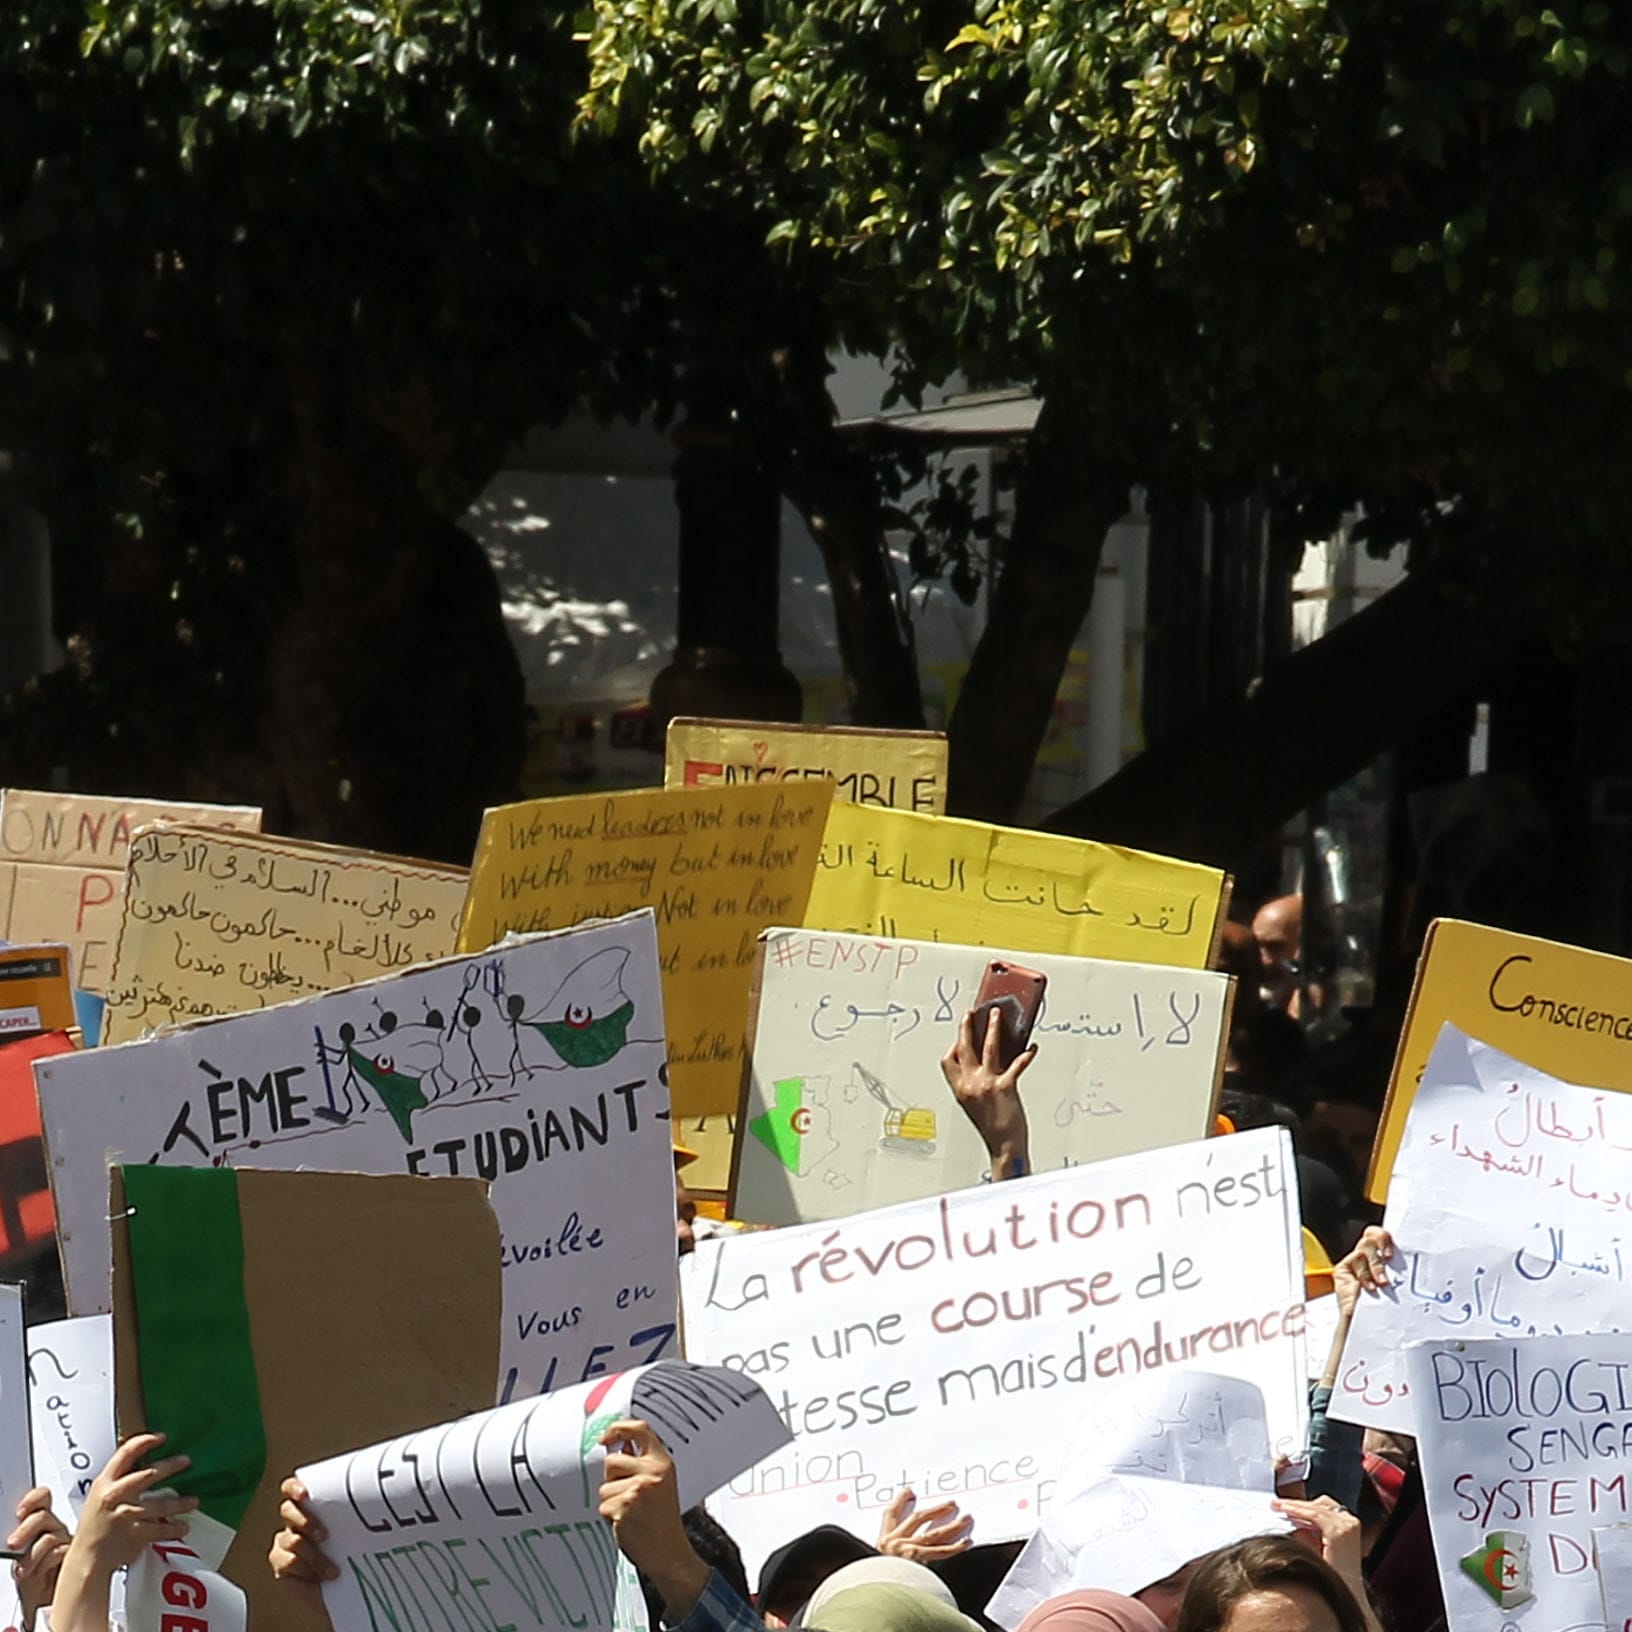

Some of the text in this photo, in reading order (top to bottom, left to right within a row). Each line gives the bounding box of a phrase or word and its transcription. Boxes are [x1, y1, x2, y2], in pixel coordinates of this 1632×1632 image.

[769, 795, 814, 829] love
[670, 842, 717, 875] but
[867, 845, 966, 892] الساعة
[983, 879, 1103, 917] حانت
[1126, 895, 1201, 935] لقد
[771, 938, 919, 978] #ENSTP
[811, 994, 921, 1041] رجوع
[704, 1153, 1287, 1310] La révolution n'est
[617, 1285, 655, 1309] en
[811, 1310, 906, 1360] une
[930, 1269, 1121, 1334] course
[1135, 1252, 1203, 1300] de
[938, 1301, 1307, 1405] mais d'endurance
